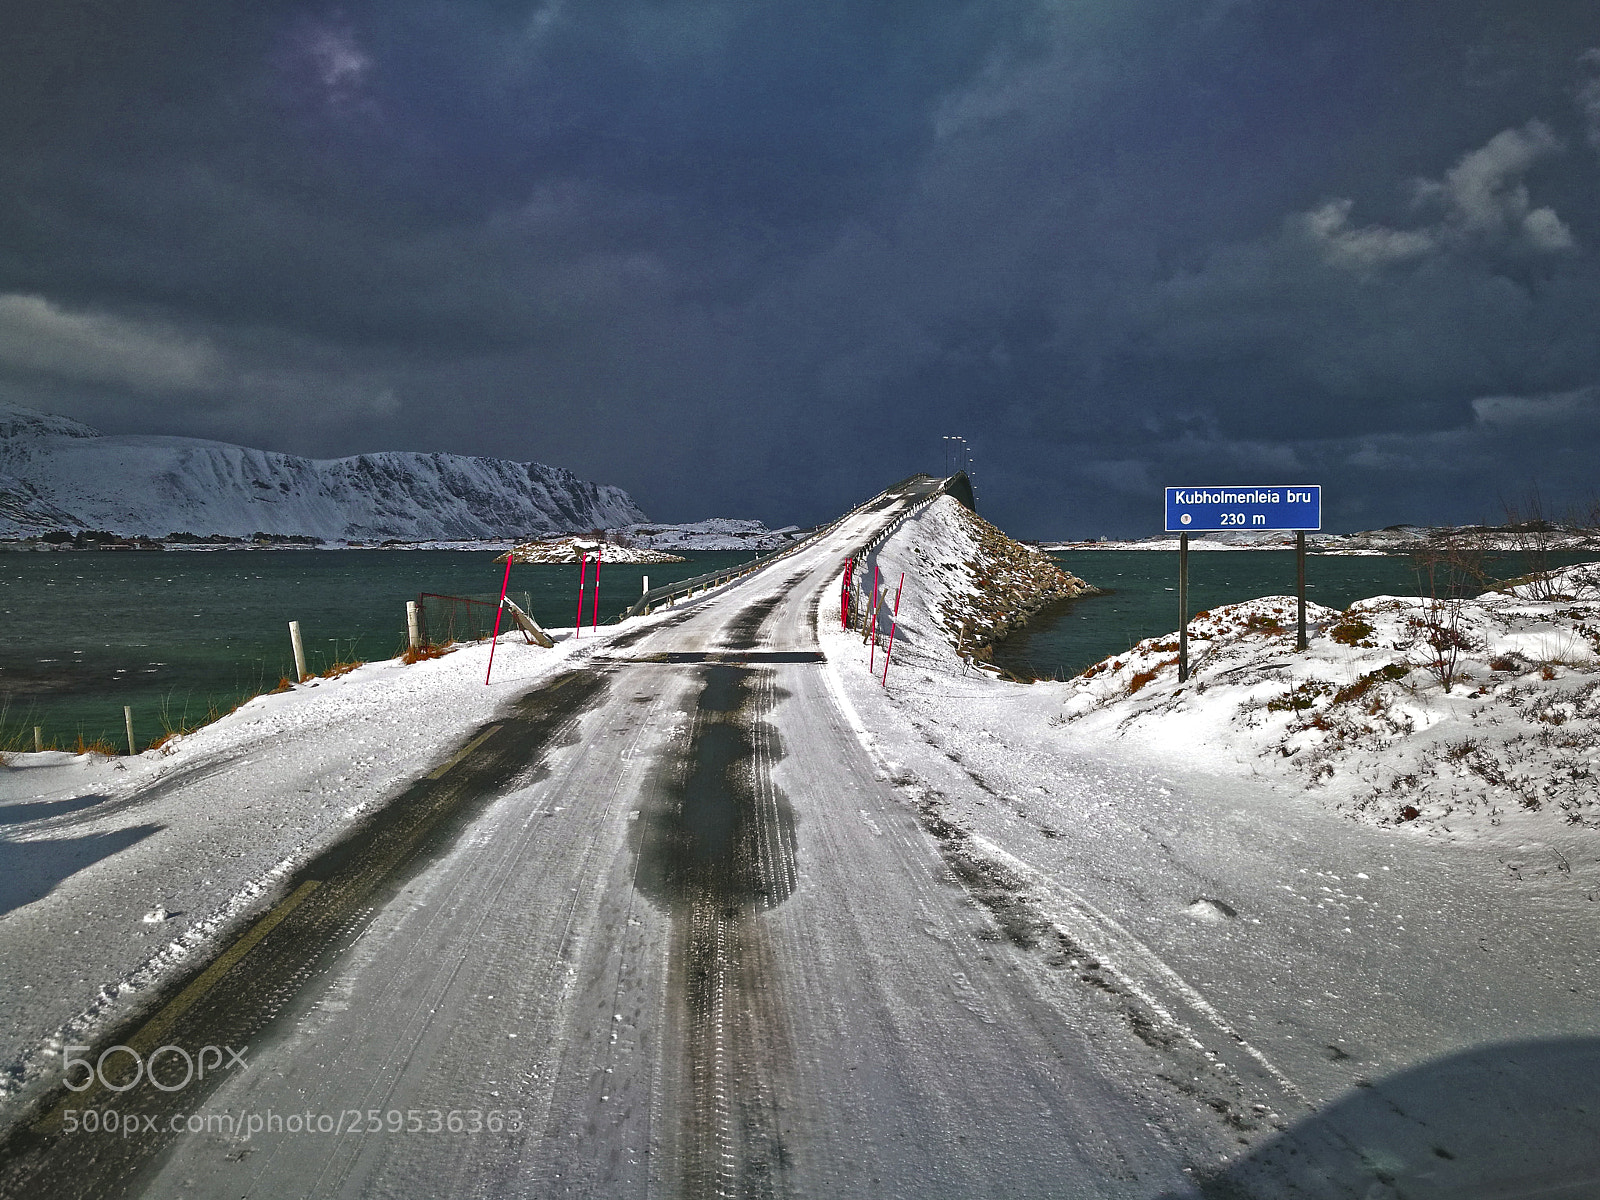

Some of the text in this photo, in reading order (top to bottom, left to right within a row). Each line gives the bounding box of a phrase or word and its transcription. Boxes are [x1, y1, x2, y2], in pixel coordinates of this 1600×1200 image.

[1175, 490, 1311, 504] Kubholmenleia bru
[1220, 513, 1266, 525] 230 m
